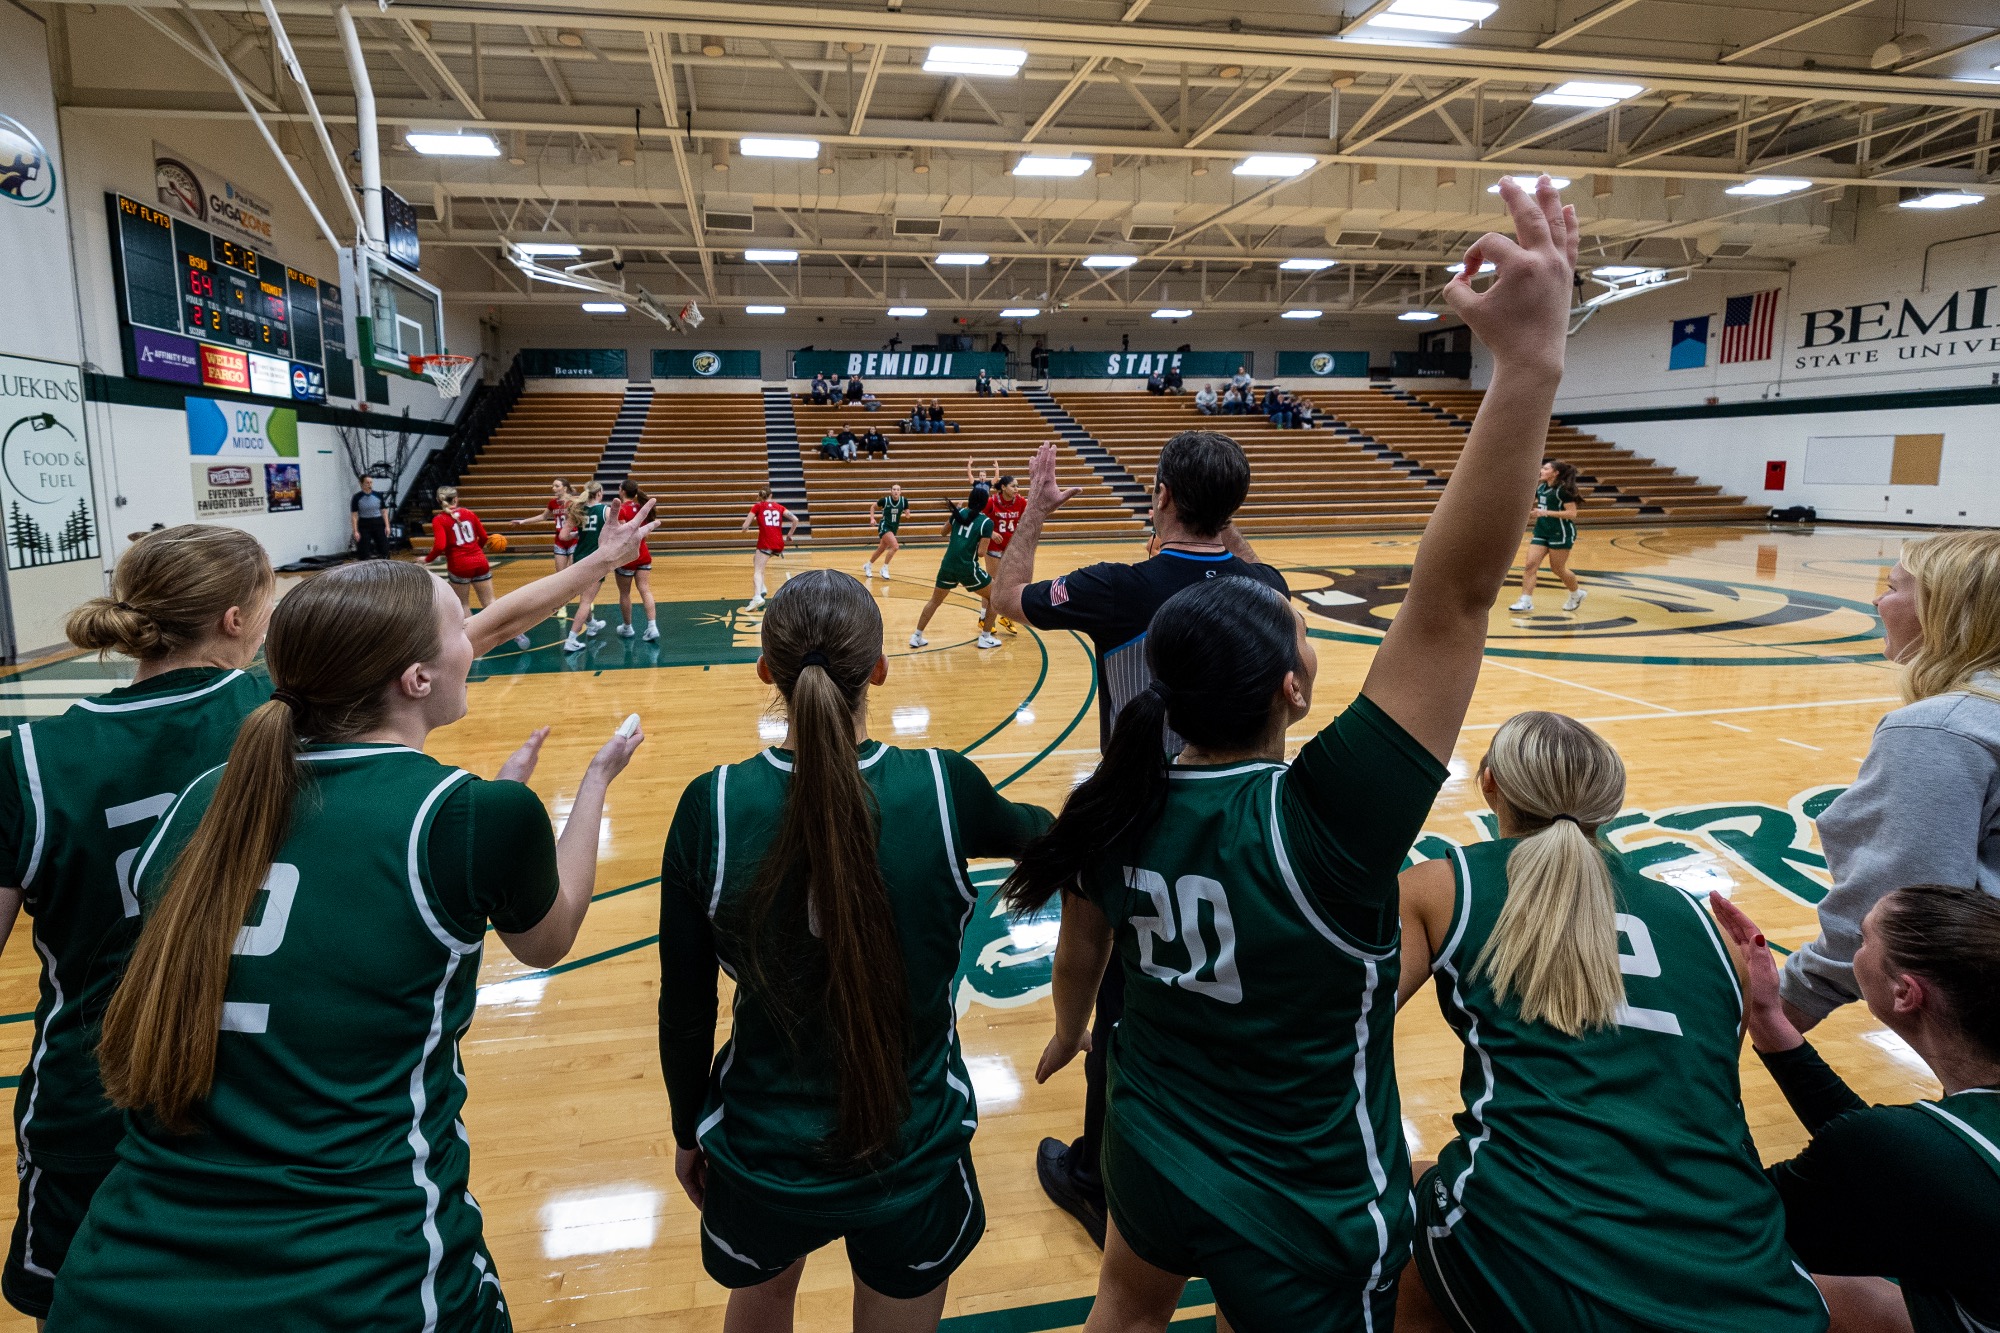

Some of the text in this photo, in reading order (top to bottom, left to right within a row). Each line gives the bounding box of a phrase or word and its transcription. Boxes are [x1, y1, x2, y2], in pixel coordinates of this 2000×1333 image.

[153, 211, 170, 229] PTS
[223, 241, 255, 274] 5:12
[190, 269, 213, 297] 64
[193, 305, 202, 325] 2
[212, 311, 220, 330] 2
[1797, 285, 2000, 349] BEMI
[263, 325, 270, 343] 2
[205, 352, 243, 370] WELLS
[847, 353, 953, 375] BEMIDJI
[1107, 353, 1183, 375] STATE
[1795, 350, 1879, 370] STATE
[208, 366, 245, 383] FARGO
[554, 366, 593, 375] Beavers
[0, 374, 79, 403] UEKEN'S
[232, 437, 264, 450] MIDCO
[73, 451, 86, 466] &
[208, 488, 254, 499] EVERYONE'S
[198, 498, 237, 511] FAVORITE
[238, 497, 264, 508] BUFFET
[763, 509, 780, 526] 22
[452, 520, 475, 546] 10
[1123, 865, 1243, 1005] 20
